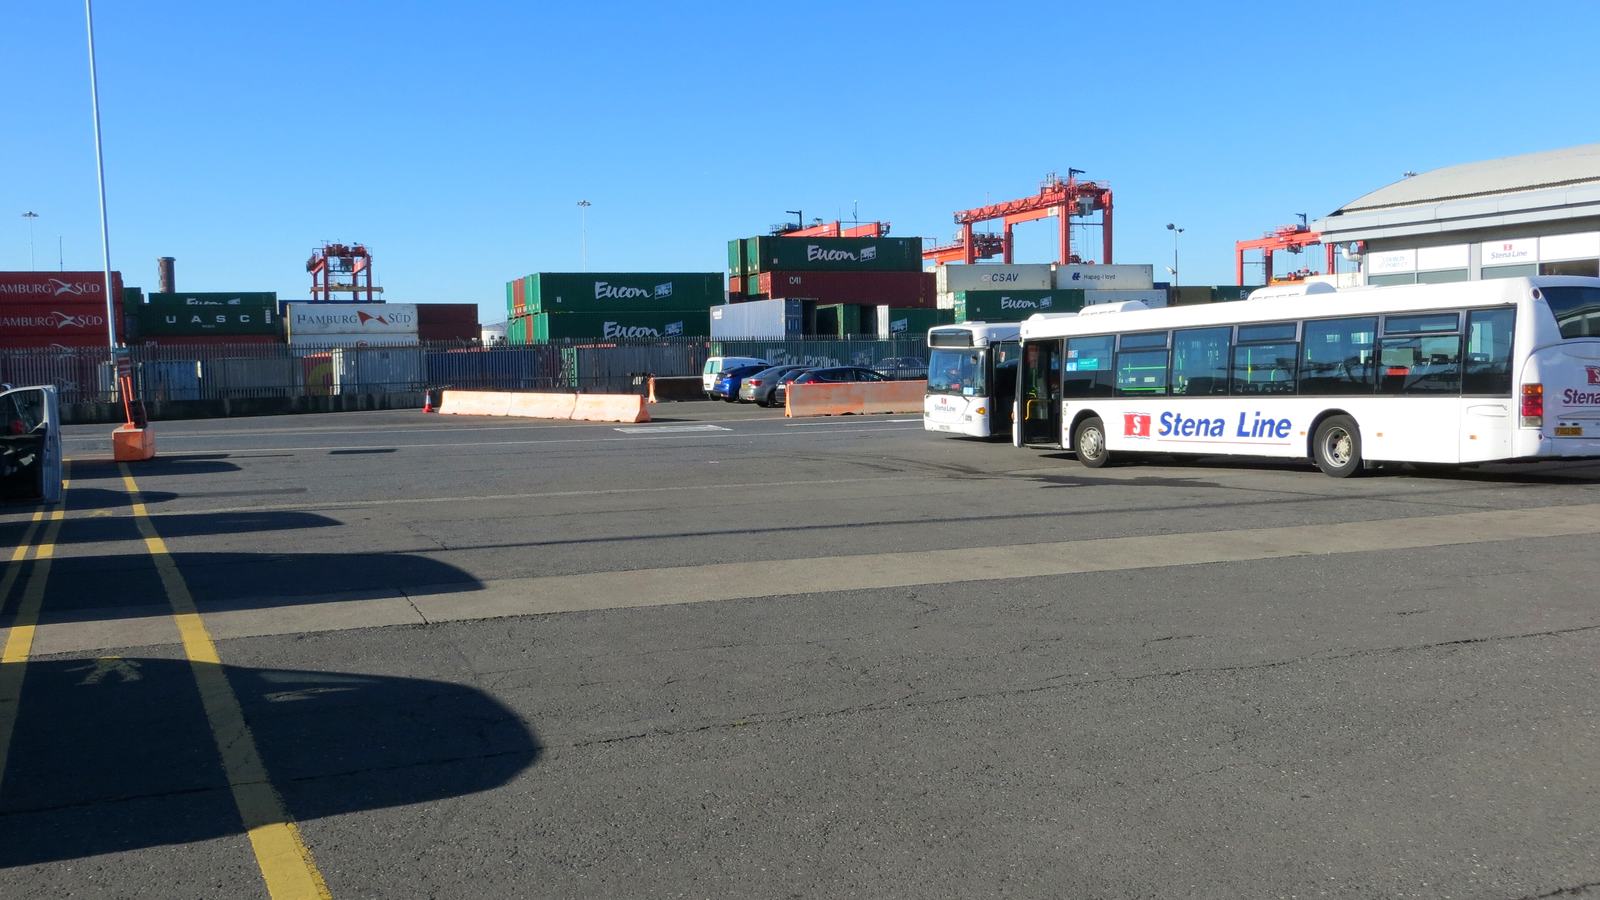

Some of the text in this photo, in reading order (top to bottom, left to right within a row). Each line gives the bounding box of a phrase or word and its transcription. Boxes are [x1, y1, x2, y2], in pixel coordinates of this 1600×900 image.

[807, 245, 859, 261] Eucon
[991, 273, 1019, 283] CSAV
[75, 282, 100, 294] SÜD
[595, 281, 653, 300] Eucon
[1001, 297, 1039, 309] Eucon
[0, 316, 103, 327] AMBURG SÜD
[388, 313, 412, 323] SÜD
[603, 321, 664, 340] Eucon
[1563, 388, 1600, 404] Stena
[1158, 411, 1225, 437] Stena
[1236, 411, 1292, 439] Line
